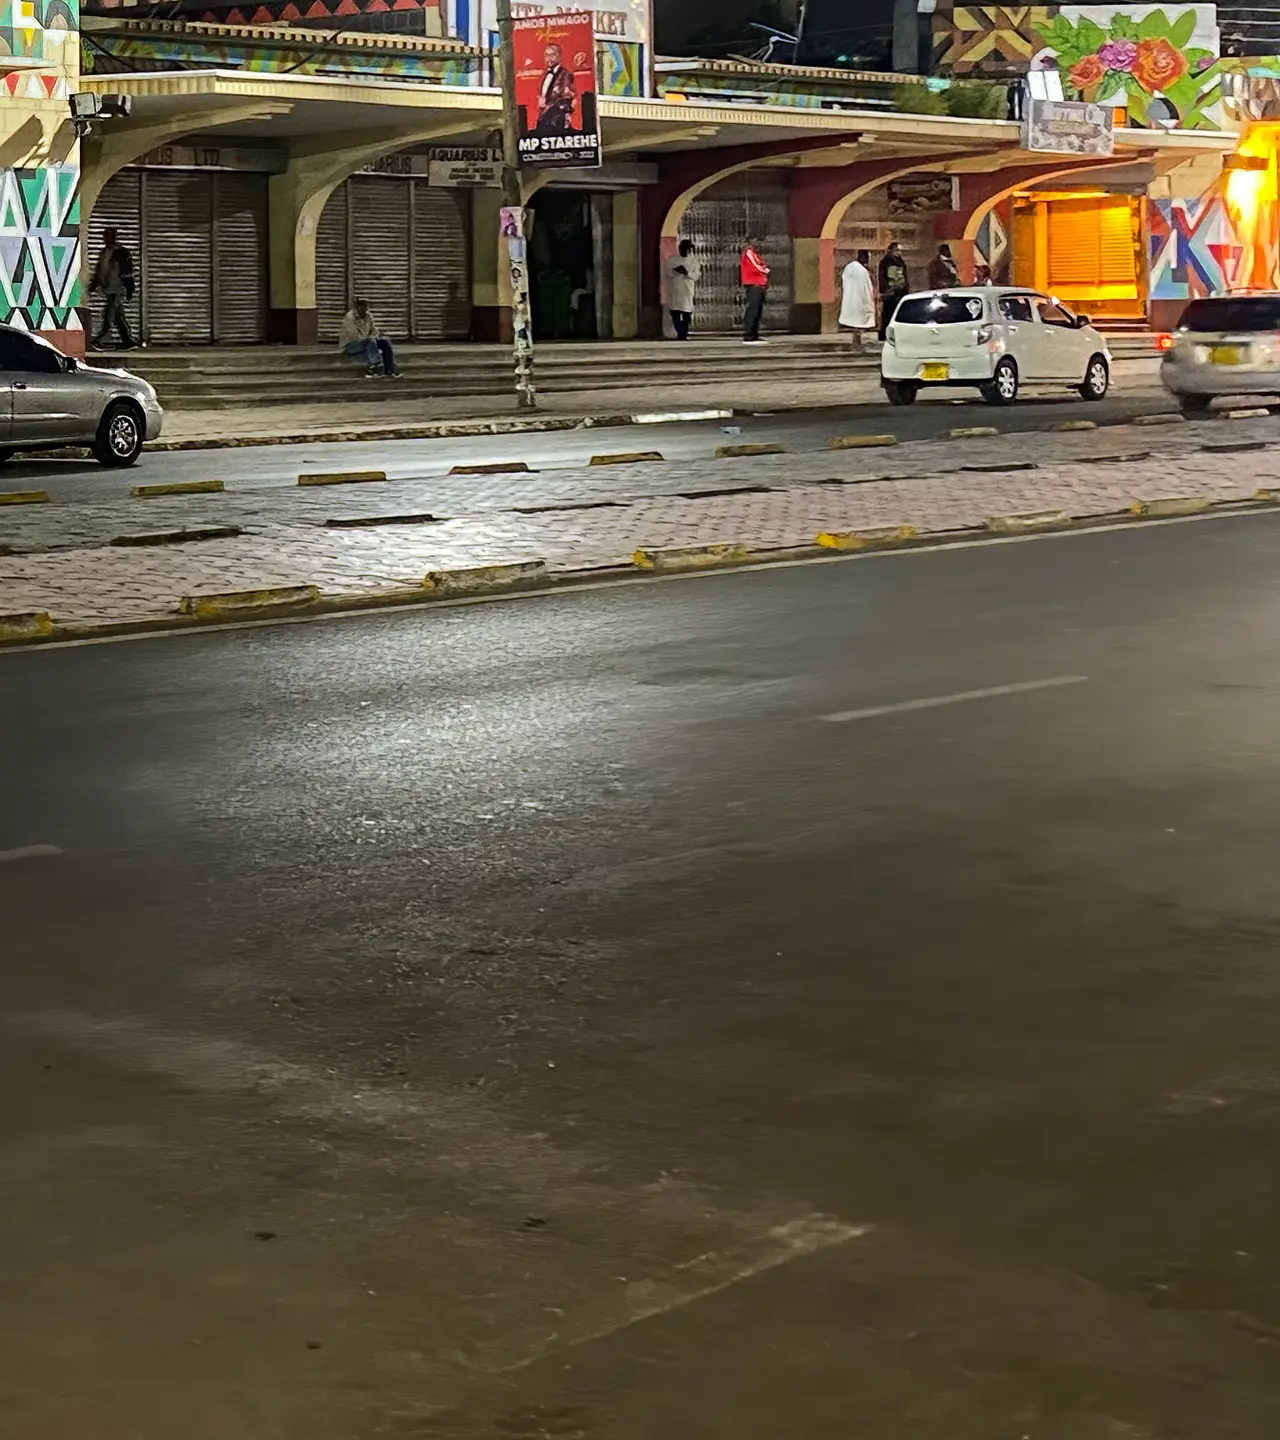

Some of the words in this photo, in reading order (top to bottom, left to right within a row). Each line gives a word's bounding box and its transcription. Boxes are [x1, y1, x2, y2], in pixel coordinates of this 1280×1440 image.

[513, 17, 545, 31] AMOS
[546, 14, 589, 28] MWAGO
[518, 138, 540, 151] MP
[541, 134, 598, 150] STAREHE
